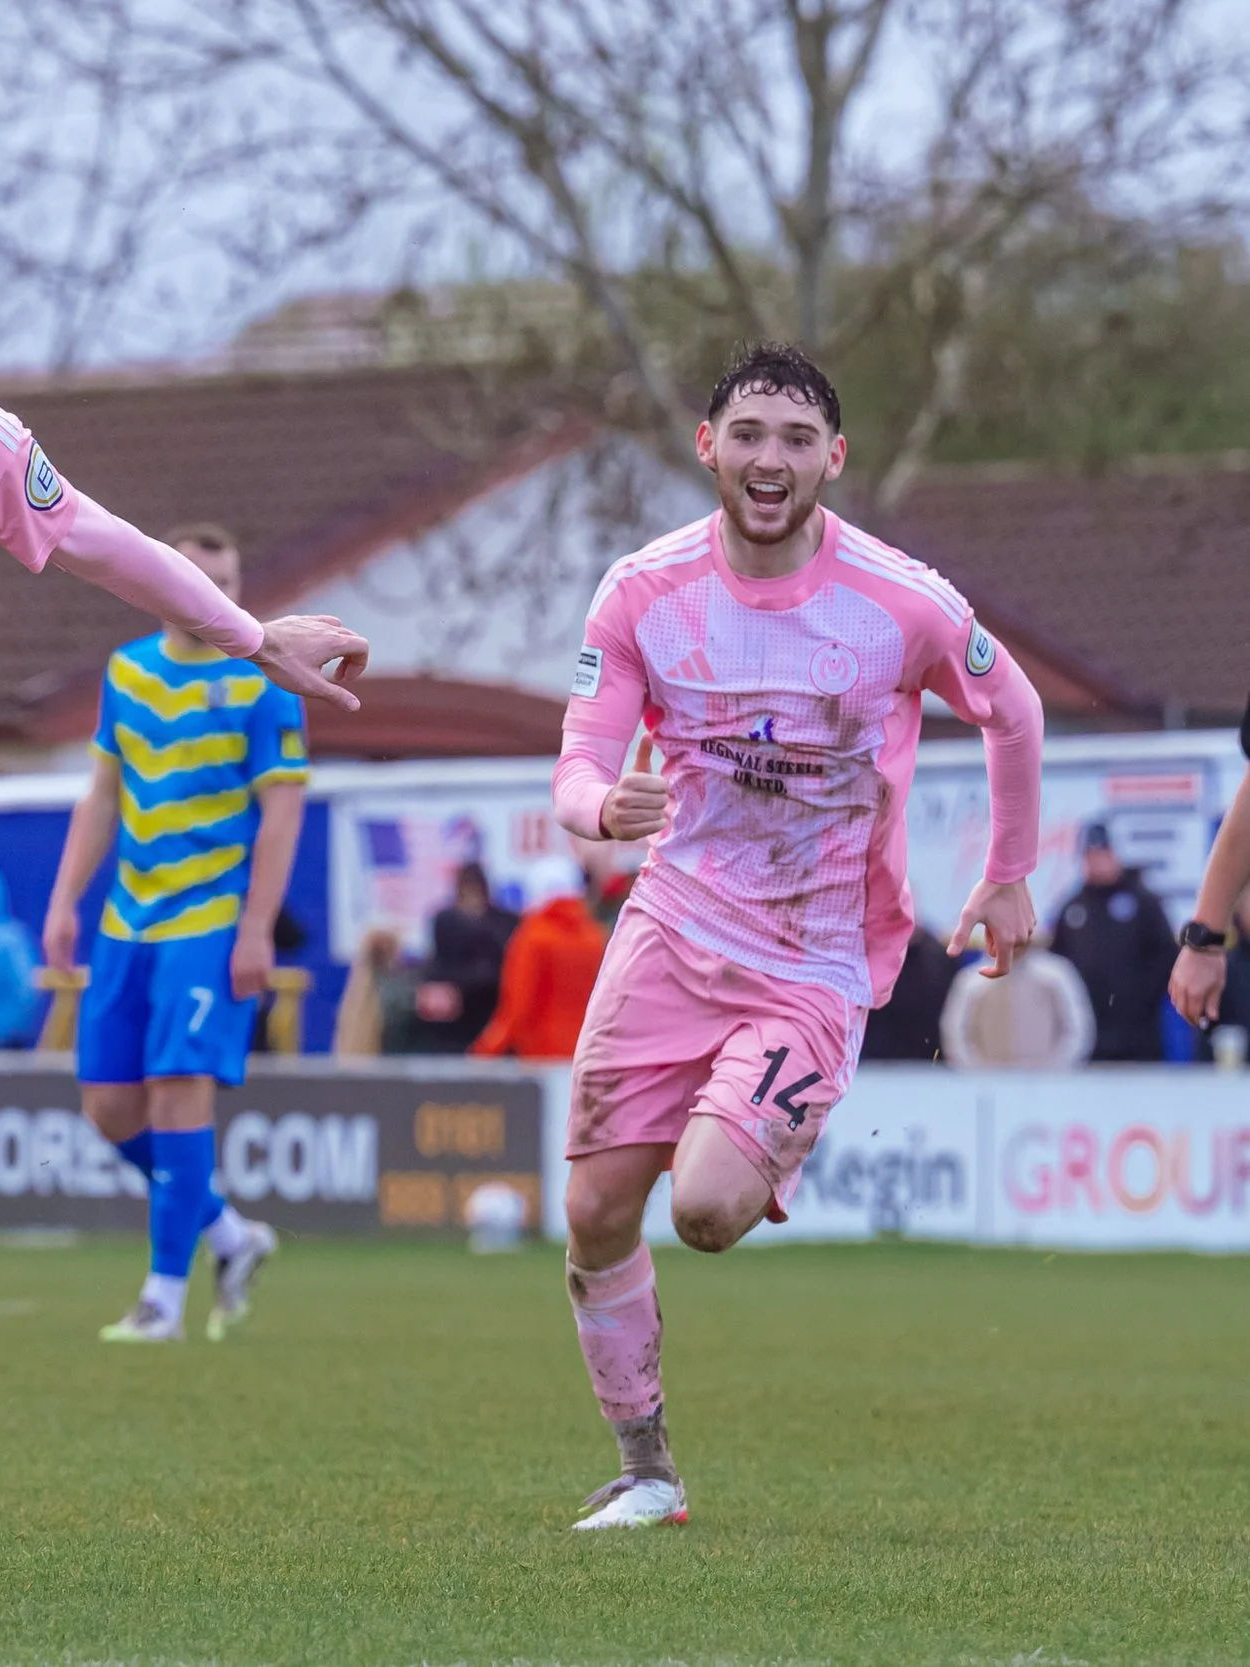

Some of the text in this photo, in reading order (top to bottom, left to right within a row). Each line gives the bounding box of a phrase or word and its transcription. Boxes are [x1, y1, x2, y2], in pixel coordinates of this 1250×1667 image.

[766, 760, 824, 775] STEELS
[188, 986, 214, 1033] 7
[750, 1046, 824, 1132] 14
